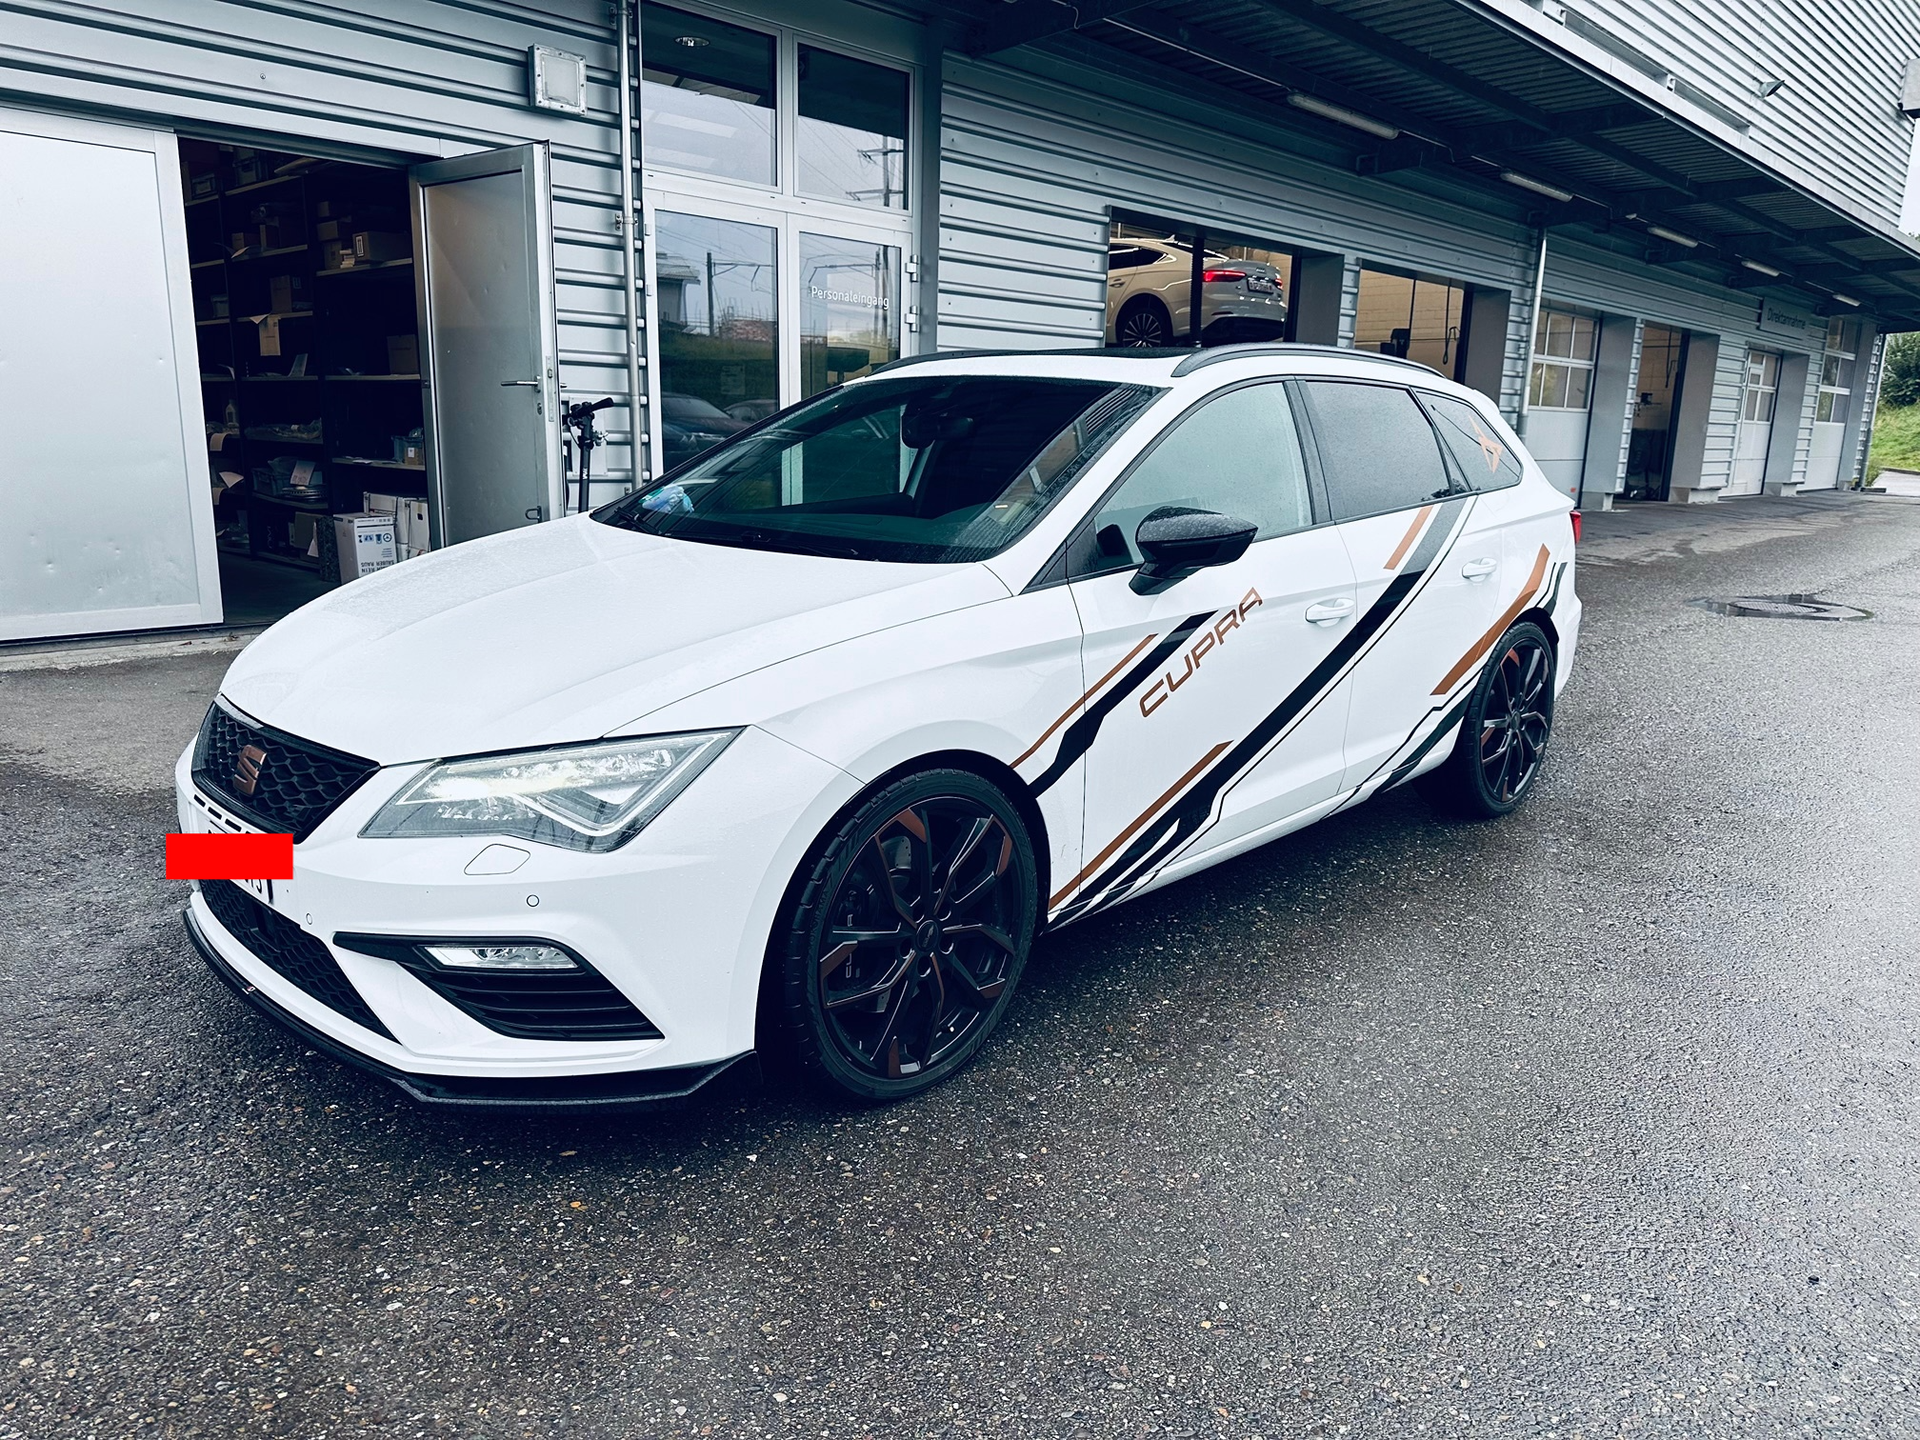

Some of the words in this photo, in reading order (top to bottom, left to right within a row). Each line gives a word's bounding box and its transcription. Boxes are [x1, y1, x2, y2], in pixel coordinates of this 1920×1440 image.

[811, 286, 889, 310] Personaleingang
[1767, 307, 1805, 330] Direktannahme
[1139, 586, 1263, 718] CUPRA
